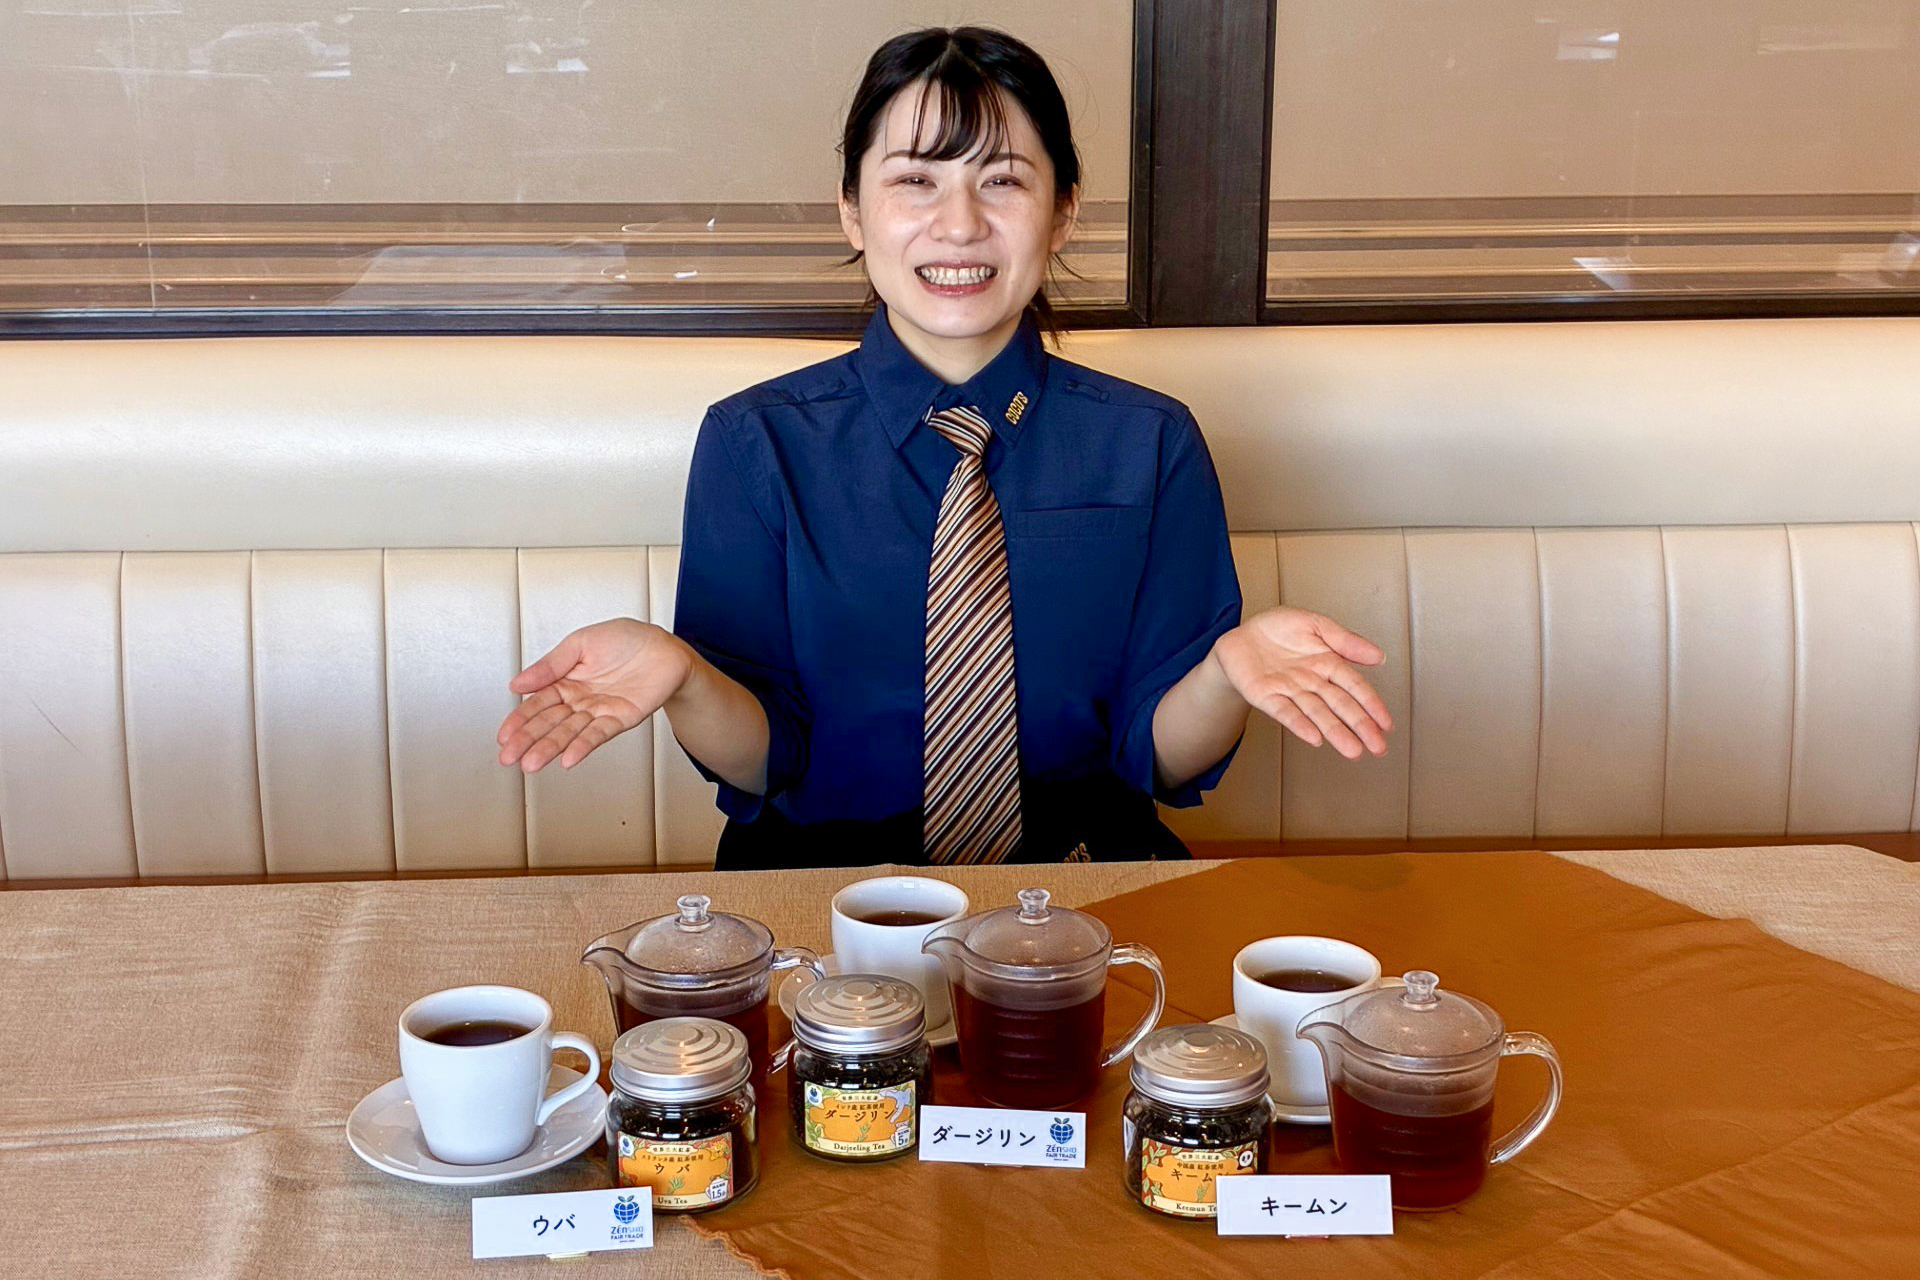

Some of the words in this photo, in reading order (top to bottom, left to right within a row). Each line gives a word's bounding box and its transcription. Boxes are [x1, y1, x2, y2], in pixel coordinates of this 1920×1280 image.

[825, 1109, 896, 1123] ダージリン
[933, 1125, 1036, 1147] ダージリン
[834, 1142, 871, 1152] Darjeeling
[654, 1162, 691, 1175] ウバ
[1171, 1168, 1228, 1182] キーム
[657, 1196, 672, 1205] Uva
[1176, 1203, 1206, 1212] Keemun
[1261, 1196, 1347, 1217] キームン
[533, 1213, 576, 1236] ウバ
